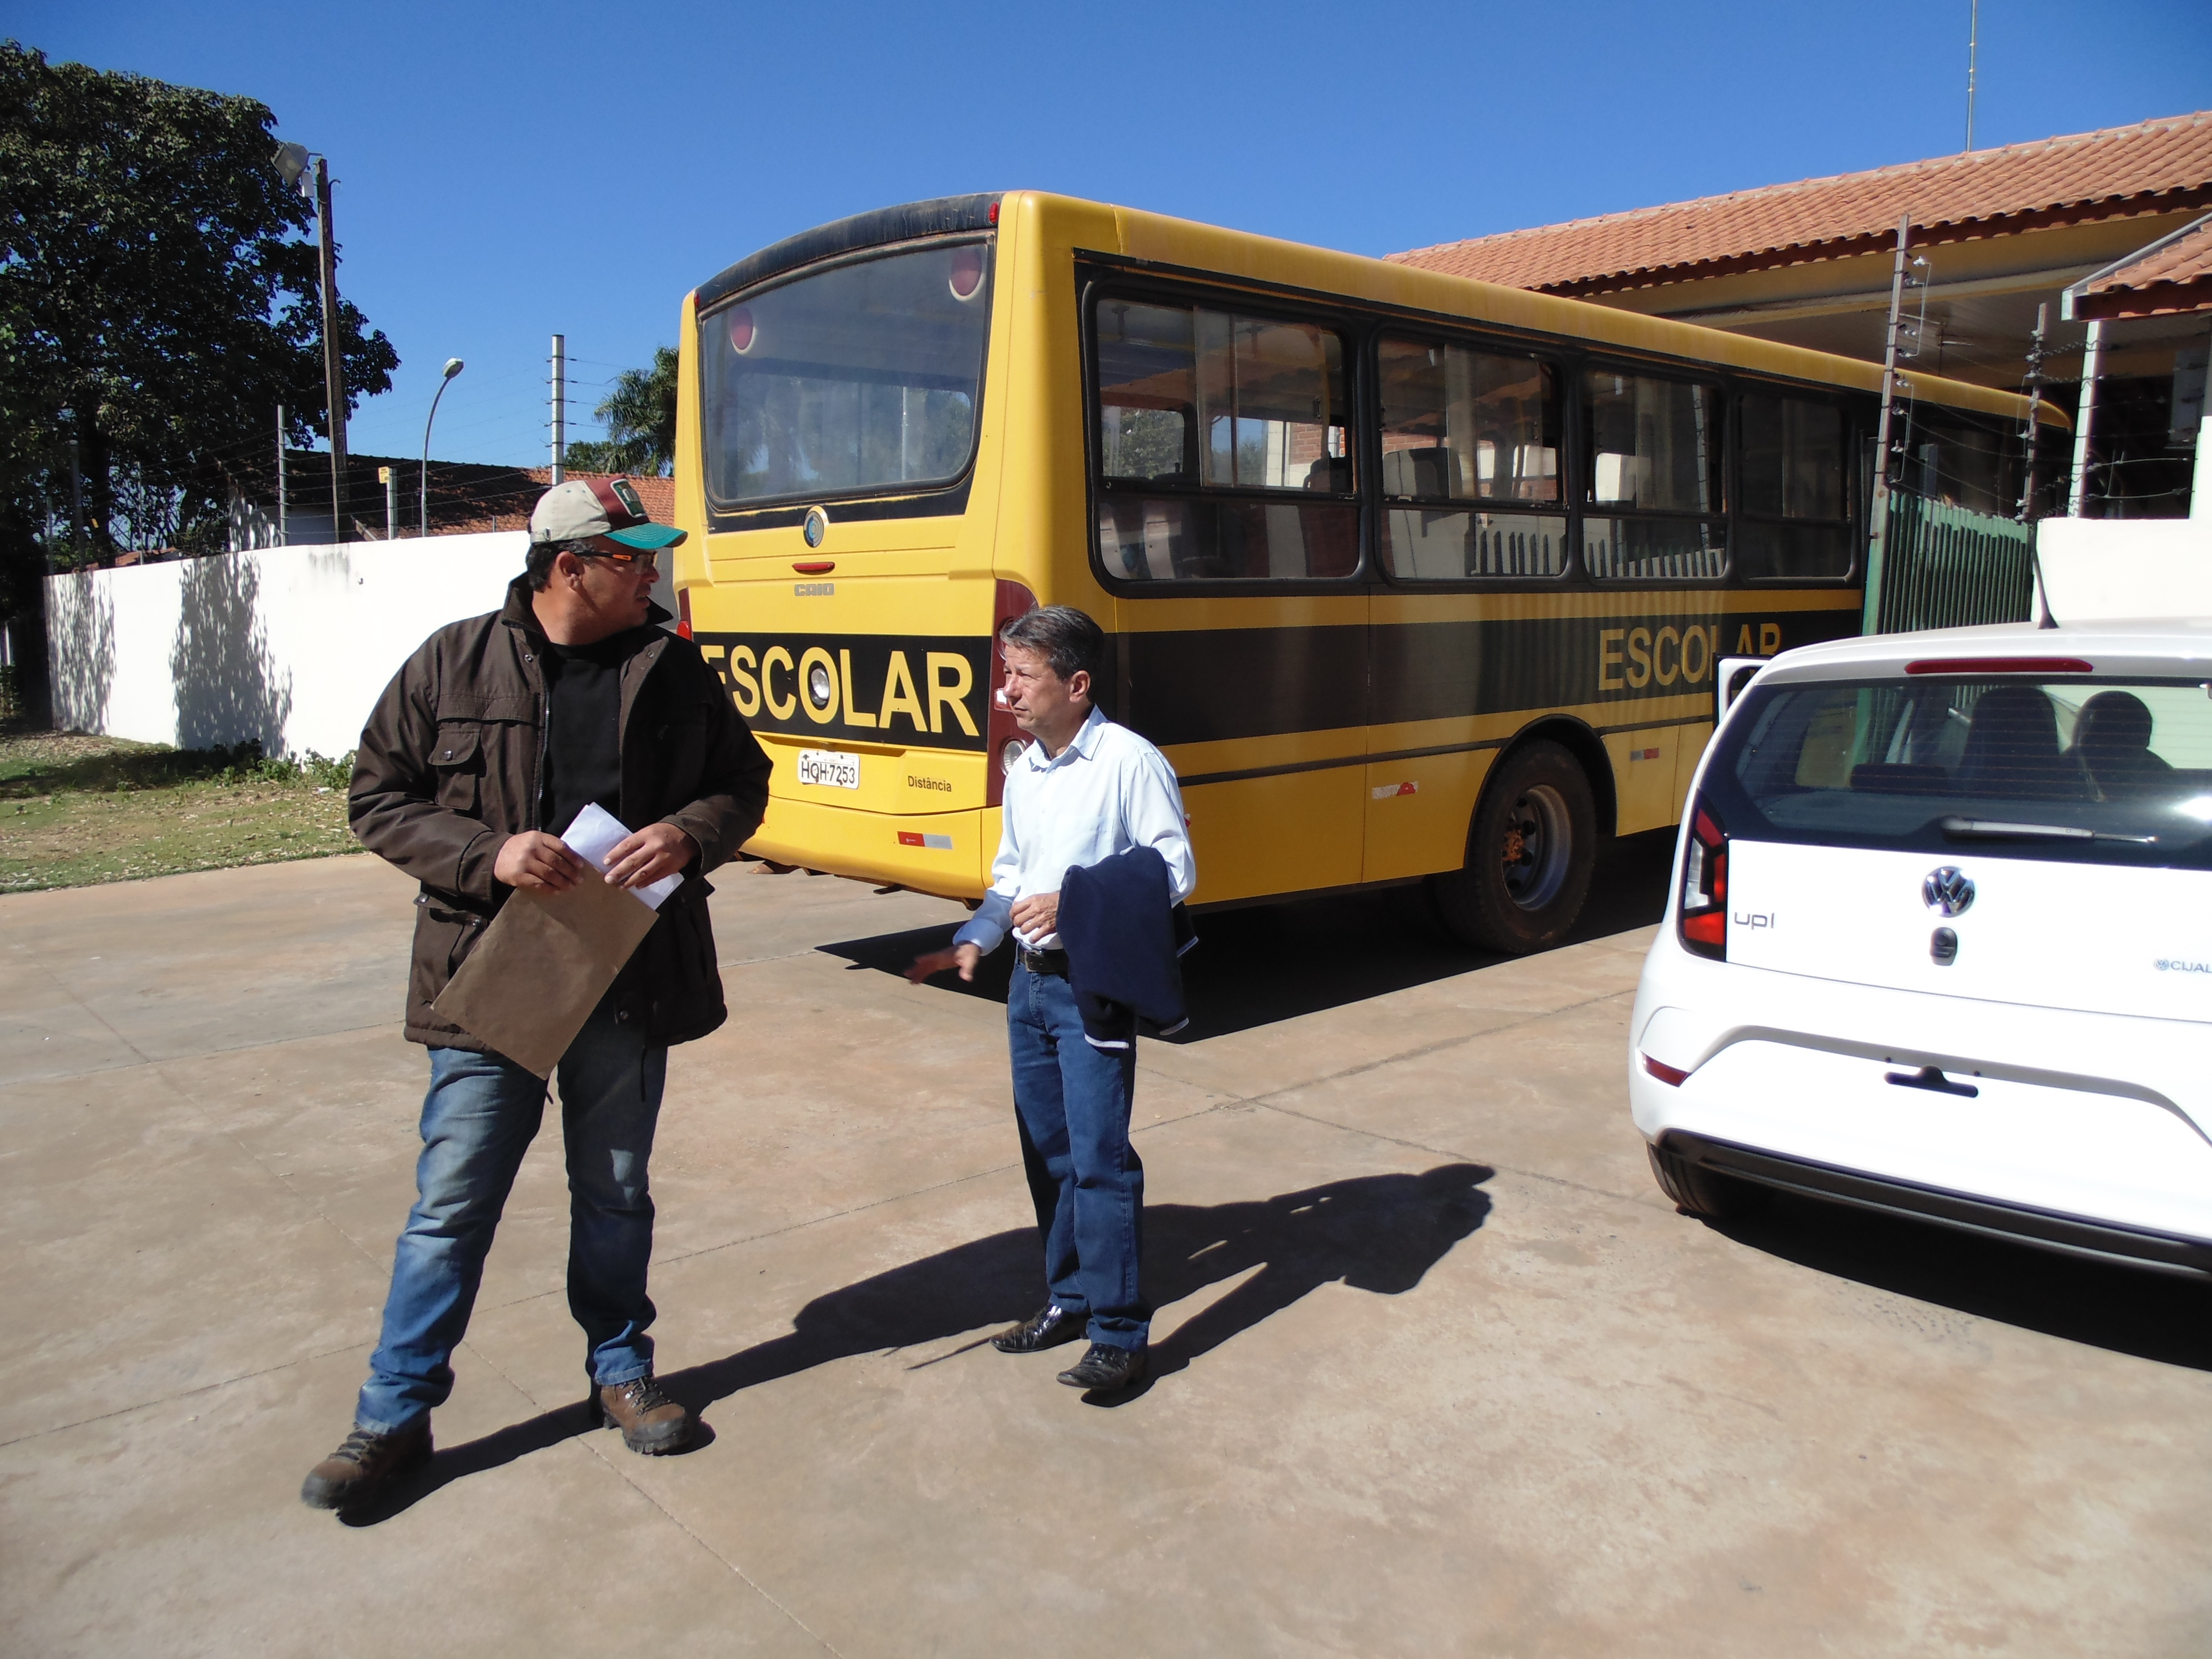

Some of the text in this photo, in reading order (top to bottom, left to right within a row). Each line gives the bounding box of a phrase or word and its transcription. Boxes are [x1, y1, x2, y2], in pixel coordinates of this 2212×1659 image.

[794, 583, 834, 596] CAIO
[700, 645, 980, 736] SCOLAR
[908, 775, 951, 792] Distância
